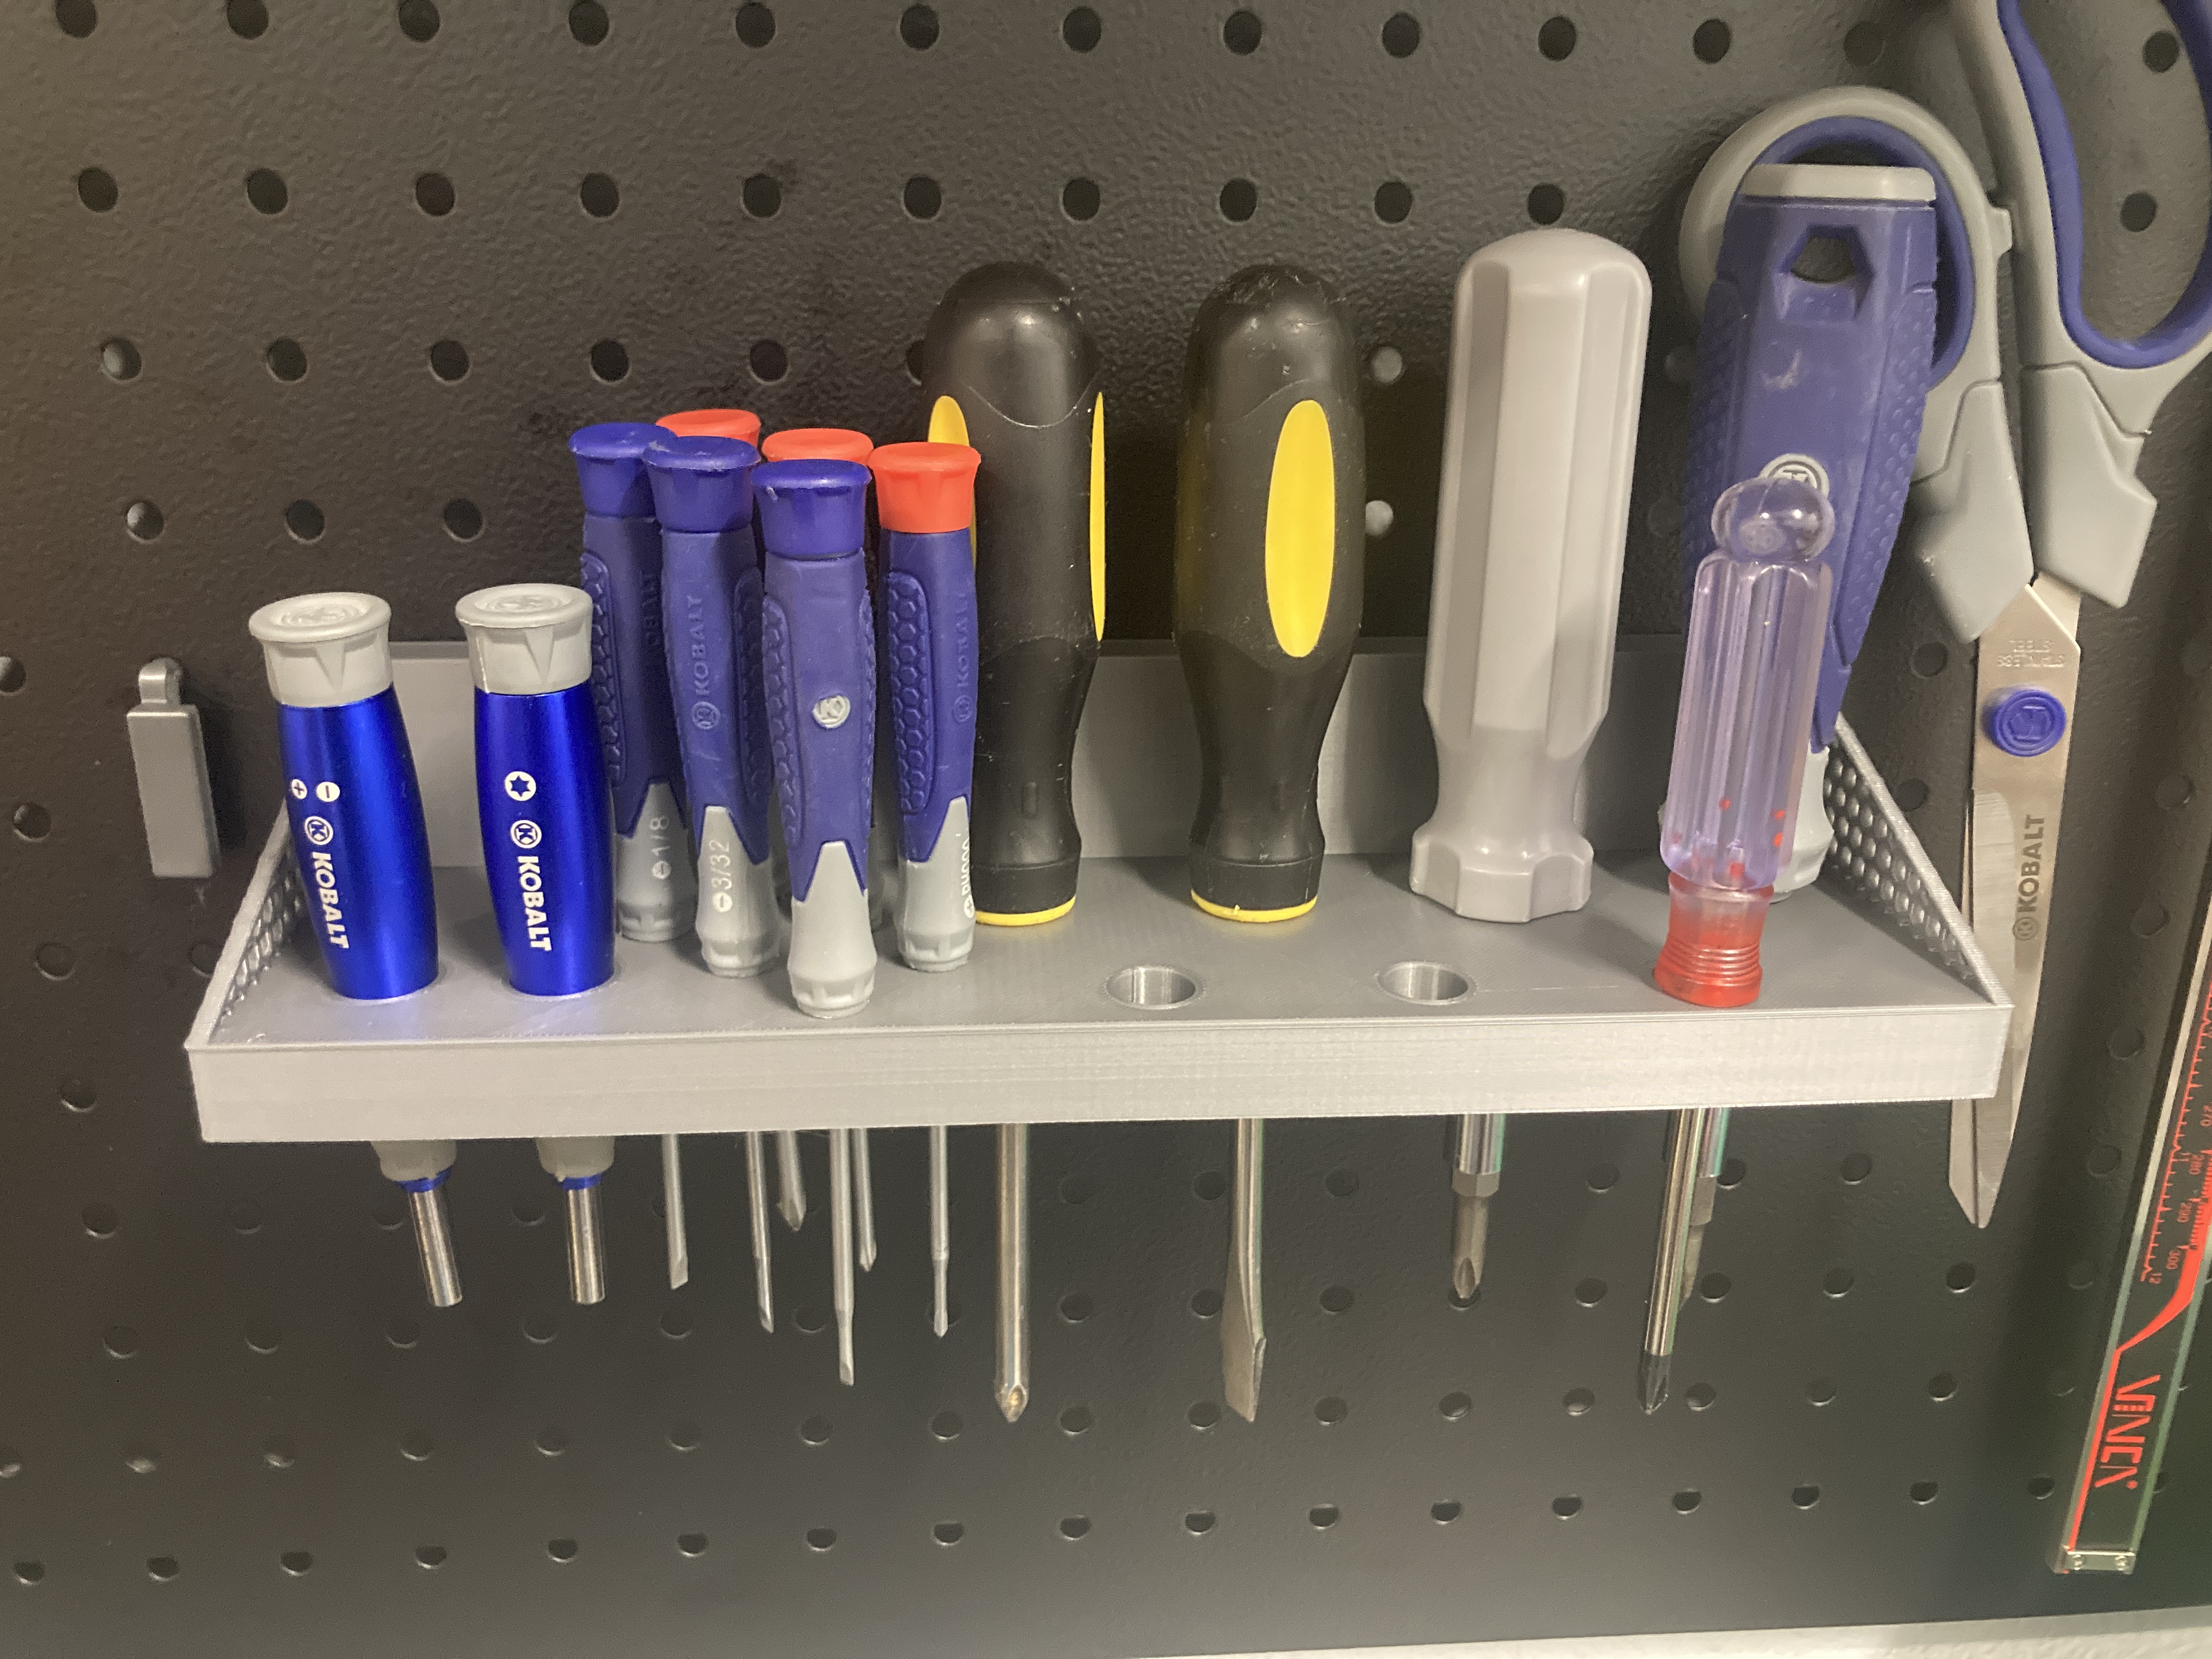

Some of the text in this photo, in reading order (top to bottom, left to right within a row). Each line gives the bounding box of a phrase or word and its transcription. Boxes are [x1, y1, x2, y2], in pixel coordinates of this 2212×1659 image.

[687, 595, 709, 696] KOBALT
[955, 589, 969, 687] KOBALT
[312, 851, 349, 949] KOBALT
[517, 856, 552, 951] KOBALT
[709, 839, 732, 890] 3/32
[2017, 814, 2045, 912] KOBALT
[2166, 1250, 2181, 1269] 300
